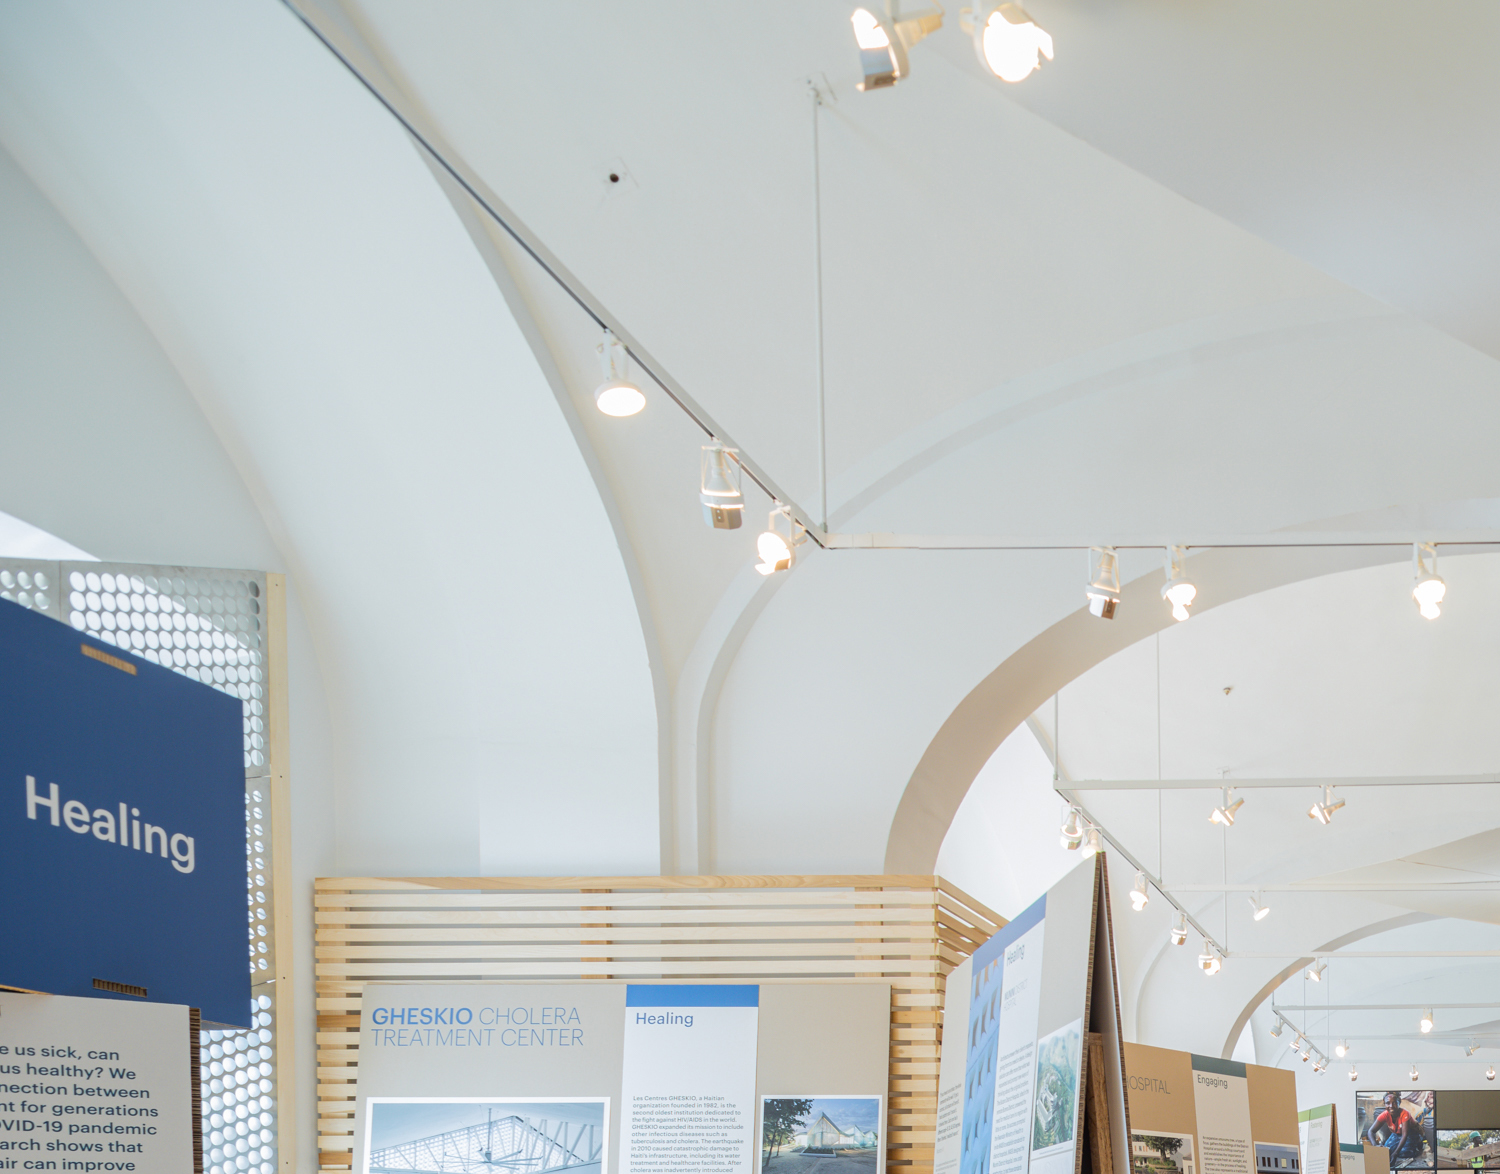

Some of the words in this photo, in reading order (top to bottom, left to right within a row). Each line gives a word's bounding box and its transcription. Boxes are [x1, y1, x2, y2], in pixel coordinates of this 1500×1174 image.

[26, 775, 195, 874] Healing
[372, 1007, 473, 1026] GHESKIO
[478, 1007, 580, 1025] CHOLERA
[636, 1011, 694, 1028] Healing
[371, 1028, 497, 1046] TREATMENT
[501, 1028, 584, 1046] CENTER
[14, 1046, 36, 1057] us
[40, 1045, 82, 1061] sick,
[87, 1050, 120, 1061] can
[0, 1064, 21, 1075] us
[26, 1062, 104, 1081] healthy?
[108, 1067, 137, 1080] We
[1197, 1074, 1228, 1089] Engaging
[73, 1083, 150, 1099] between
[20, 1100, 47, 1114] for
[51, 1104, 159, 1118] generations
[0, 1119, 63, 1133] VID-19
[68, 1121, 157, 1136] pandemic
[46, 1138, 104, 1153] shows
[107, 1140, 144, 1153] that
[23, 1160, 57, 1170] can
[62, 1157, 136, 1173] improve
